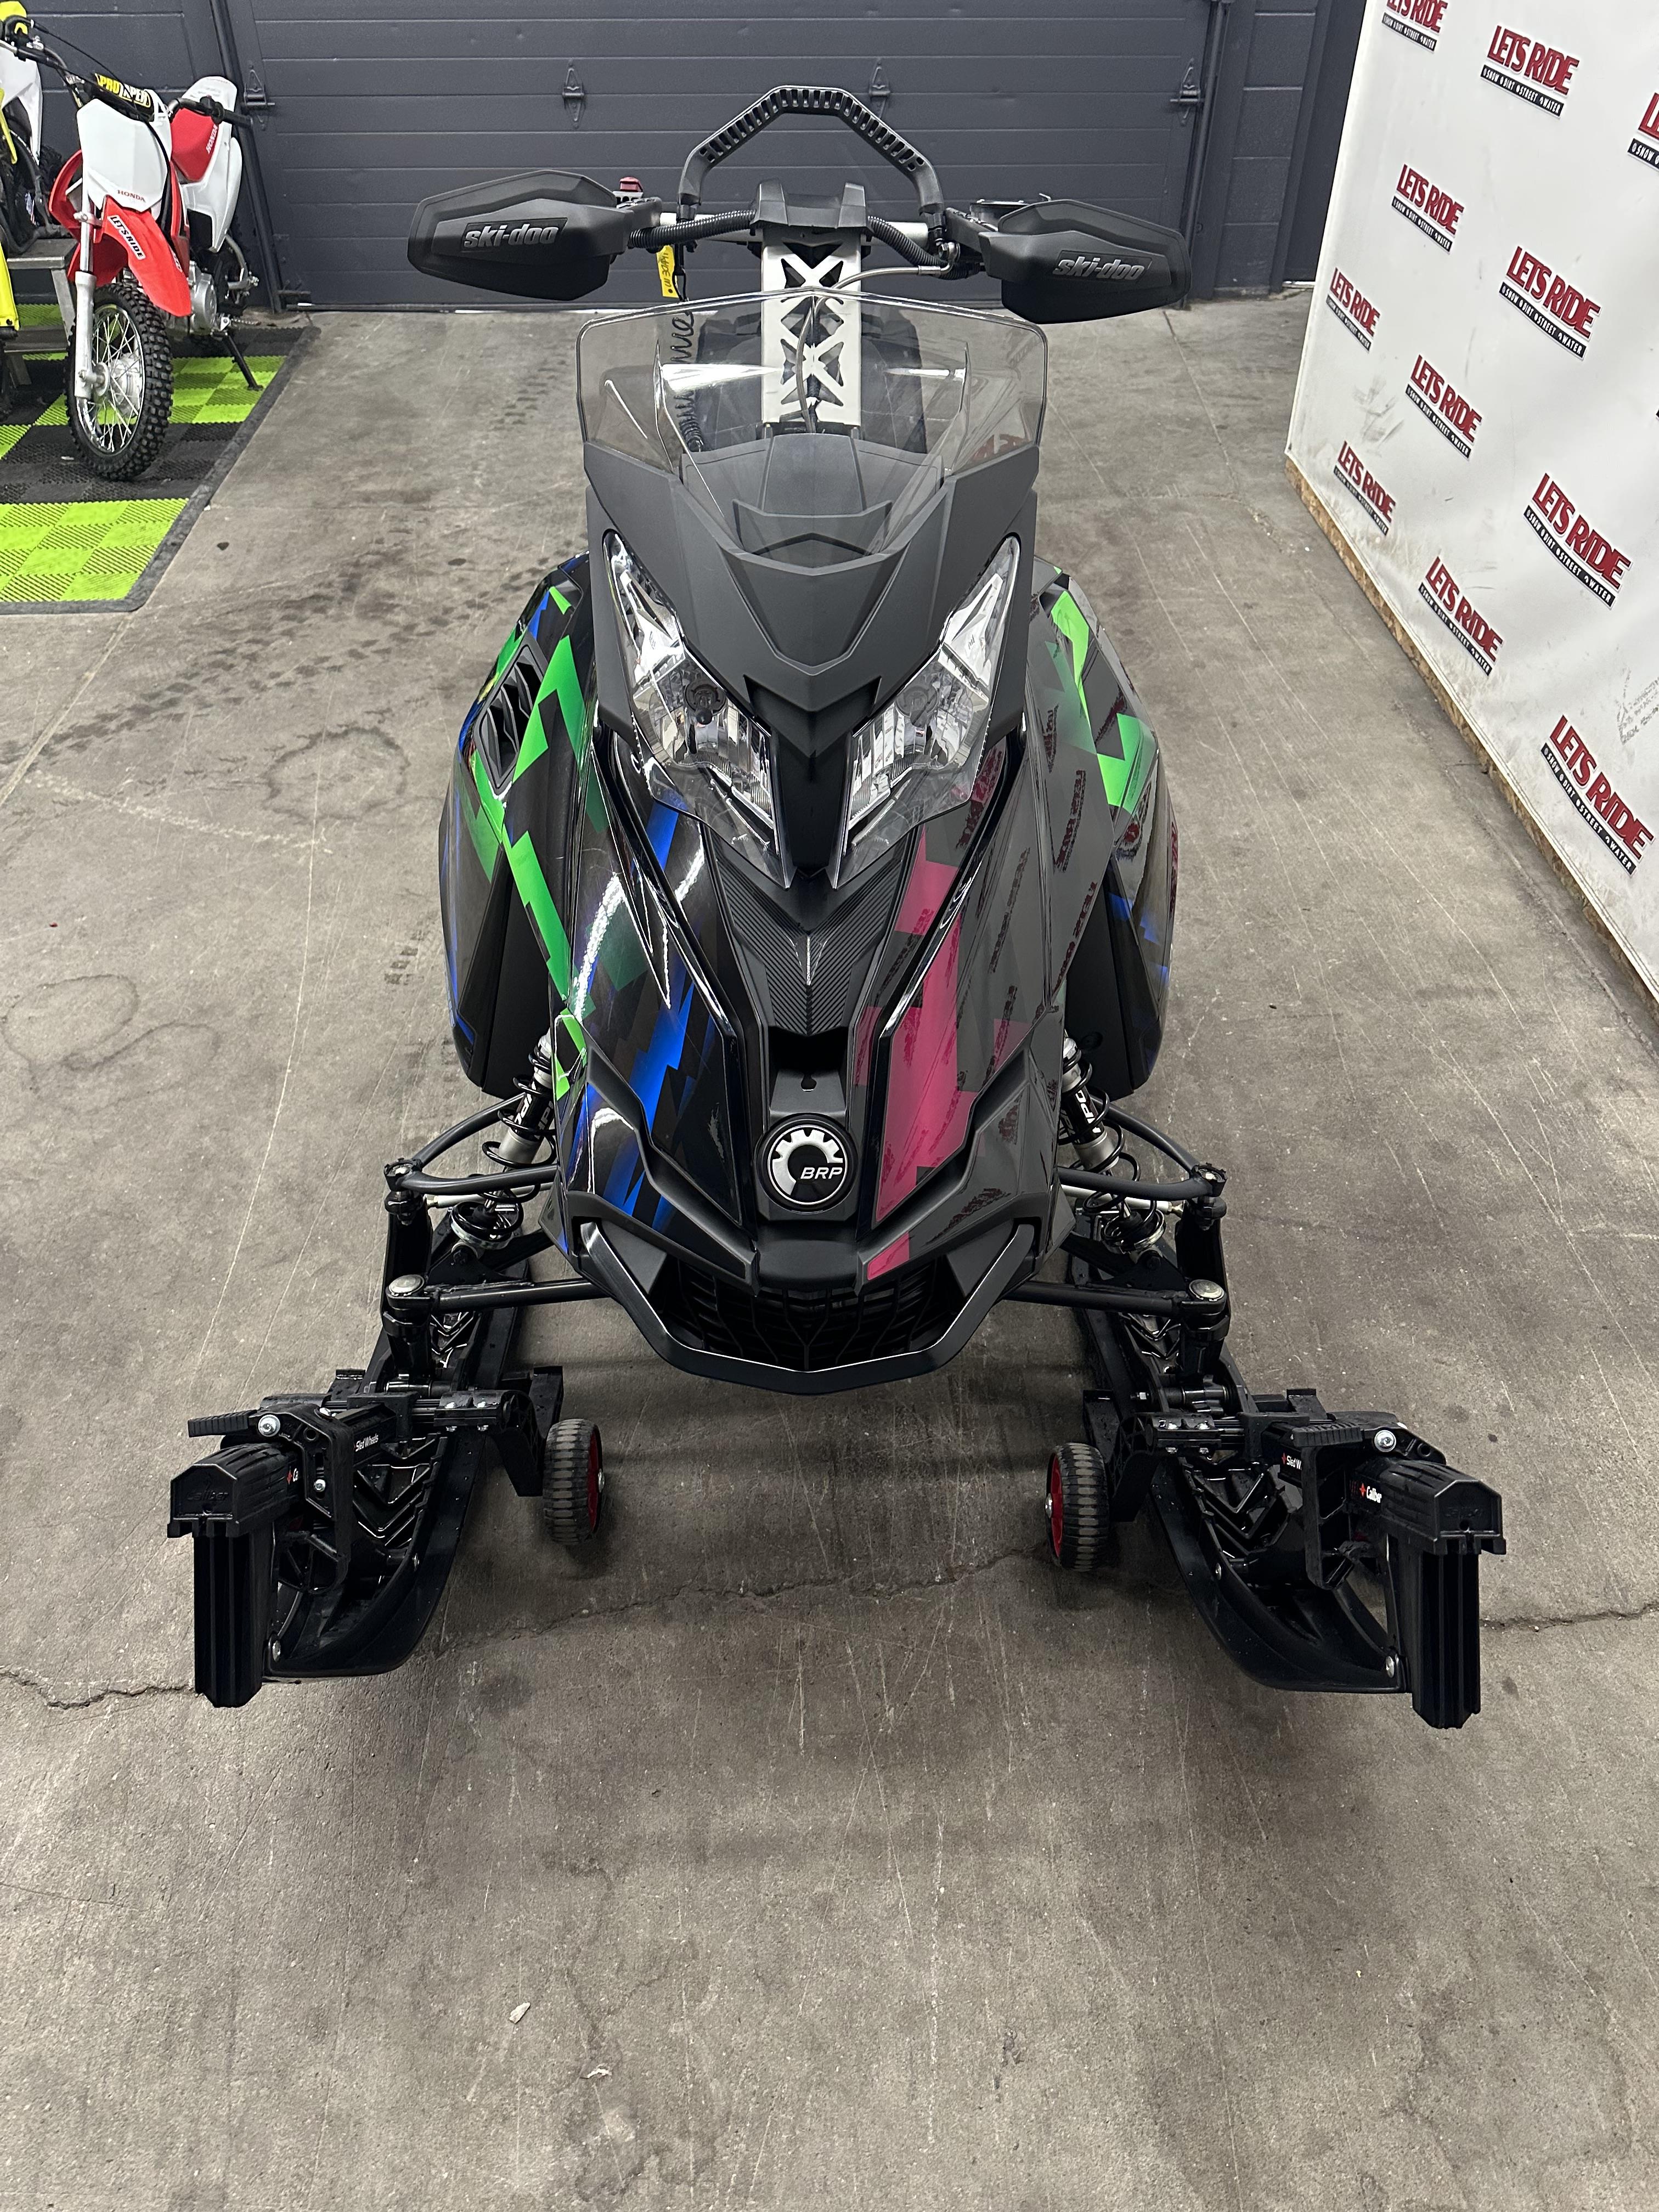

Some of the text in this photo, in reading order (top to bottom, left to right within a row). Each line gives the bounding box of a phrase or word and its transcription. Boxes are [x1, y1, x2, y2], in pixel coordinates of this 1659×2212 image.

[1524, 42, 1579, 95] RIDE
[1519, 87, 1538, 102] STREET
[1543, 98, 1560, 114] WATER
[1636, 145, 1655, 161] SNOW
[117, 189, 146, 203] HONDA
[1424, 184, 1464, 235] RIDE
[126, 236, 144, 258] RIDE
[464, 223, 558, 247] ski-doo
[1052, 256, 1145, 280] ski-doo
[1350, 290, 1380, 337] RIDE
[1543, 275, 1601, 339] RIDE
[1537, 316, 1556, 336] STREET
[1562, 335, 1582, 354] WATER
[1439, 384, 1482, 443] RIDE
[1362, 470, 1396, 523] RIDE
[1543, 534, 1555, 549] DIRT
[1559, 552, 1582, 576] STREET
[1588, 579, 1611, 603] WATER
[1565, 515, 1632, 590] RIDE
[1454, 595, 1503, 662] RIDE
[1547, 753, 1632, 870] SNOW DIRT STREET WATER
[1585, 771, 1654, 860] RIDE
[800, 1167, 843, 1180] BRP
